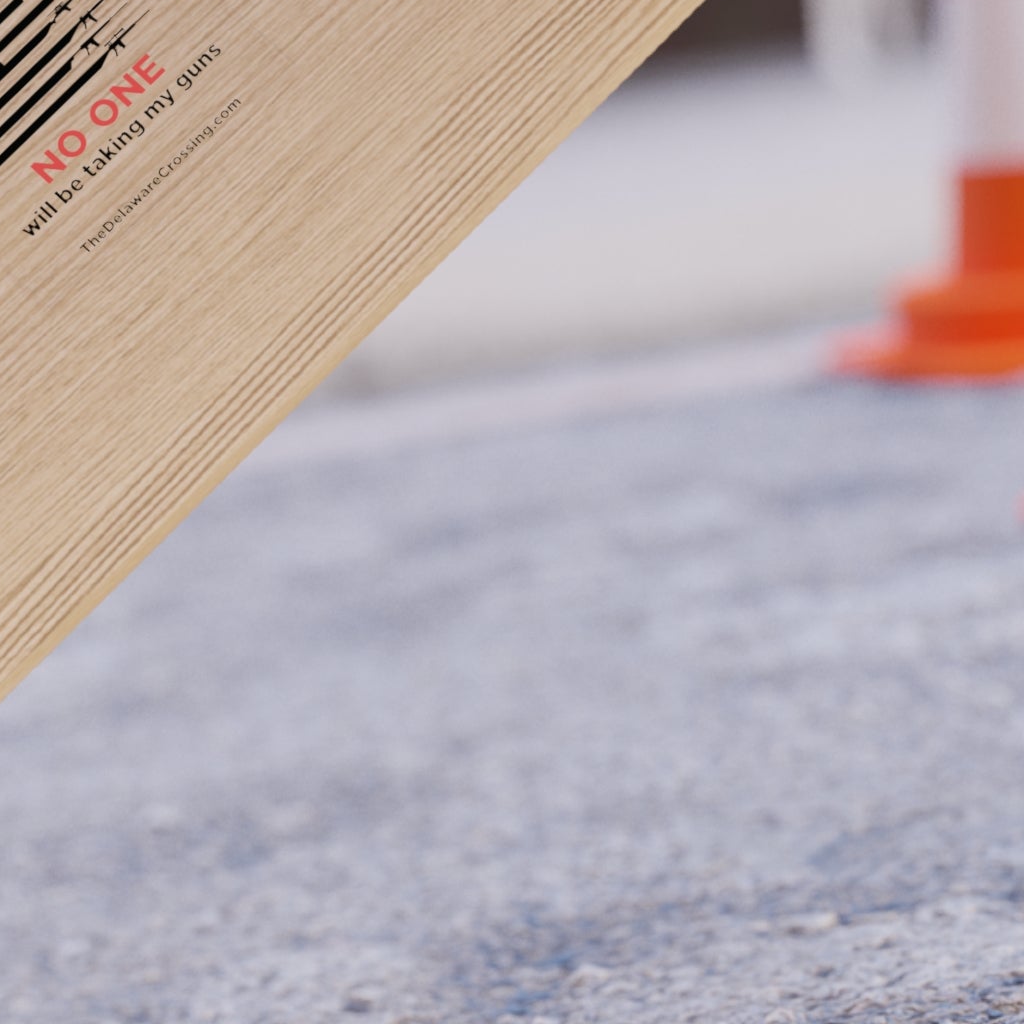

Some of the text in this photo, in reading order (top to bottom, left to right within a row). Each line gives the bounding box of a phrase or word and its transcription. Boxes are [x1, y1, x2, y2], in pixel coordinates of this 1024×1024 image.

[22, 43, 223, 237] will be taking my guns
[30, 53, 166, 184] NO ONE
[79, 97, 242, 254] TheDelawareCrossing.com
